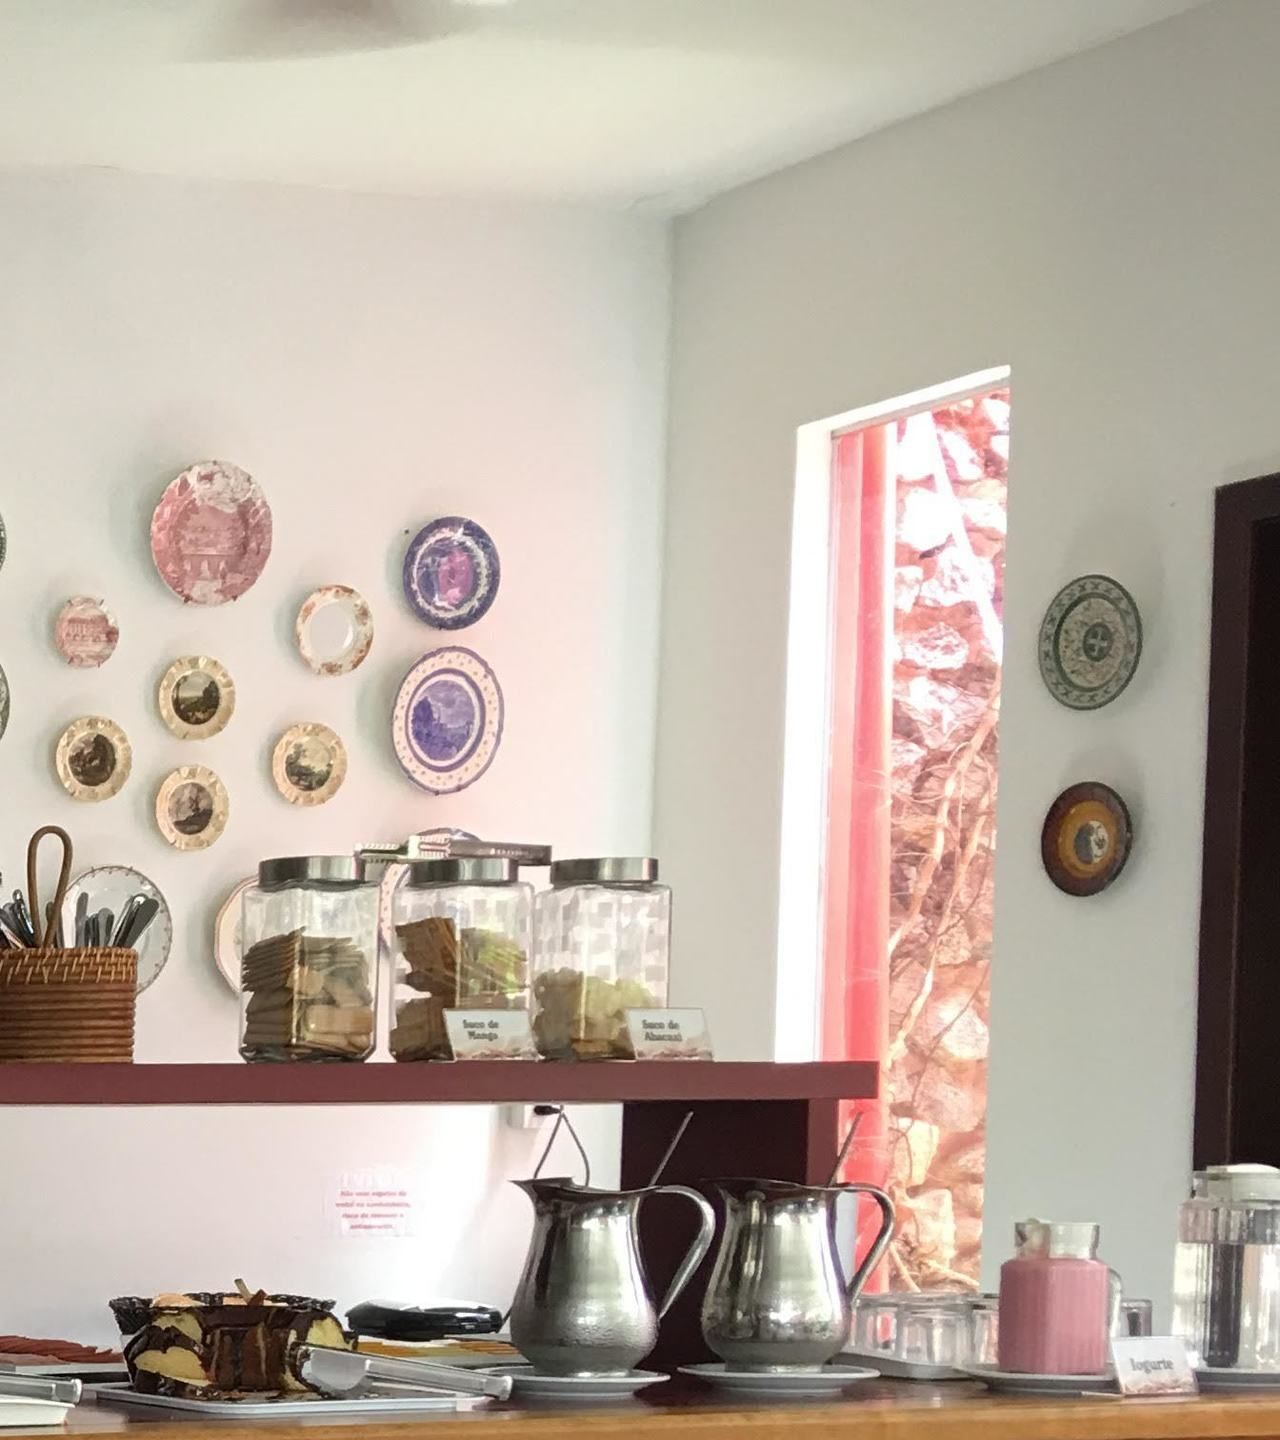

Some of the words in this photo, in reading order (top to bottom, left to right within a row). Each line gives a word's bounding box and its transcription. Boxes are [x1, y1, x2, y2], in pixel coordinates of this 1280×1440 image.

[462, 1018, 486, 1029] Suco
[487, 1018, 500, 1029] de
[641, 1018, 666, 1030] Suco
[668, 1018, 681, 1030] de
[1130, 1357, 1175, 1374] Iogurte
